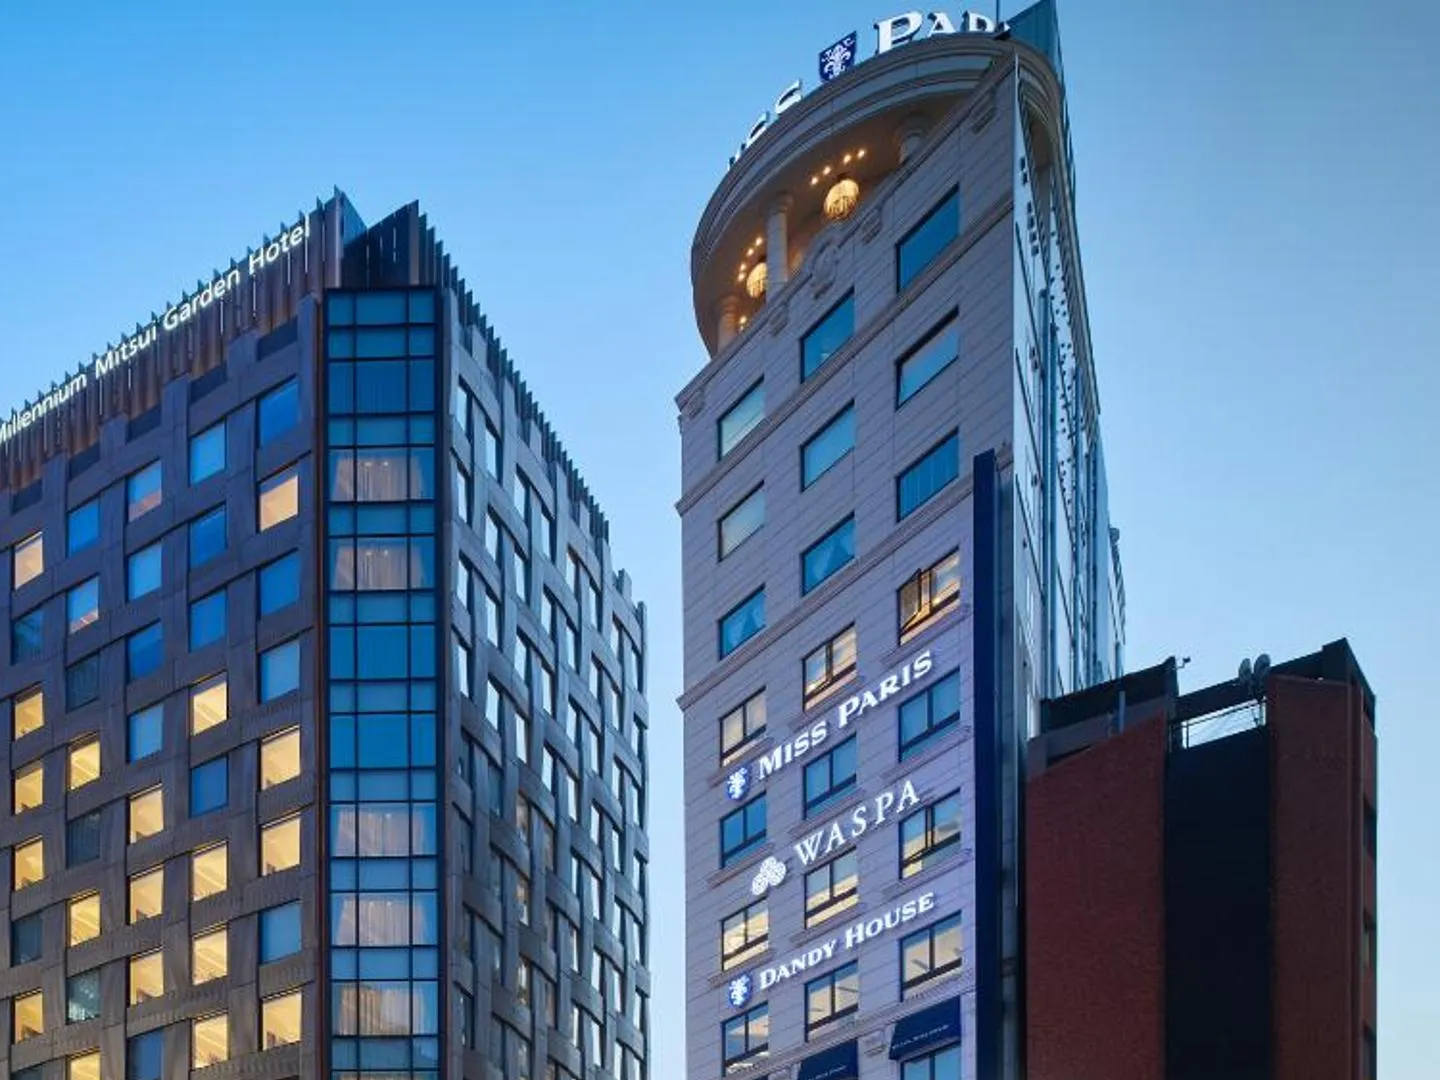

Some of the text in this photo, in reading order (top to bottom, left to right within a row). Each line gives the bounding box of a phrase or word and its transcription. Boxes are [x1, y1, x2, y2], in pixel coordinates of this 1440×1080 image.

[95, 321, 157, 373] Mitsui
[162, 270, 240, 330] Garden
[249, 213, 310, 275] Hotel
[757, 650, 933, 780] MISS PARIS
[793, 780, 920, 866] WASPA
[760, 892, 935, 989] DANDY HOUSE
